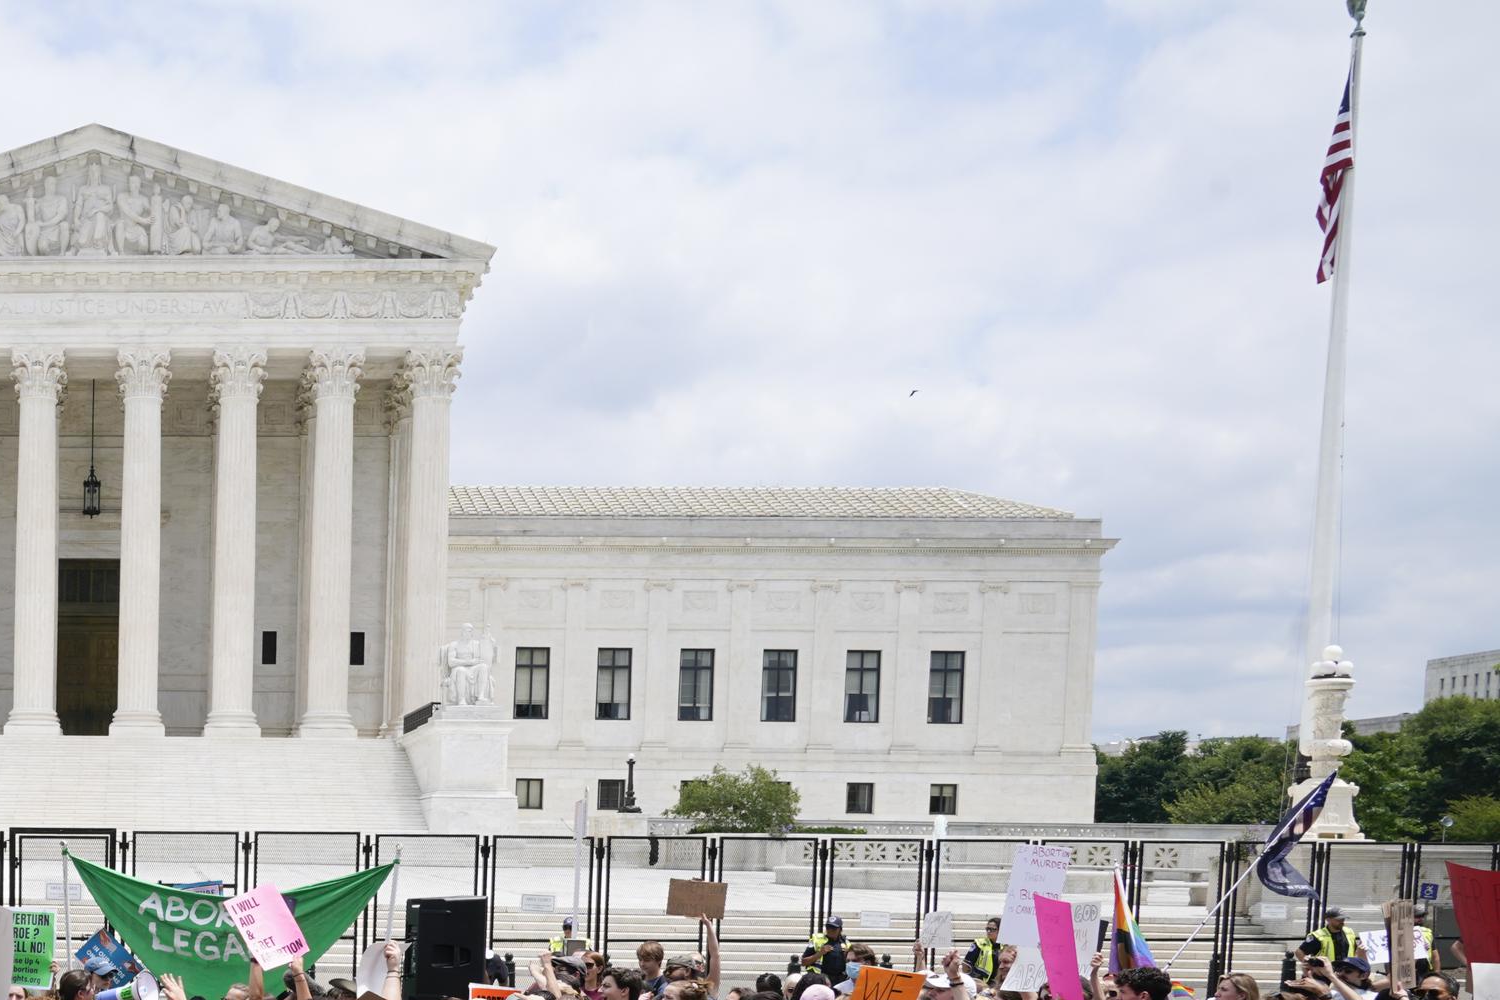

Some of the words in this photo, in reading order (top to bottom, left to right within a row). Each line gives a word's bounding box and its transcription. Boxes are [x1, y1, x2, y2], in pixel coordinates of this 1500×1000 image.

[28, 299, 104, 315] JUSTICE
[116, 299, 180, 315] UNDER
[192, 299, 229, 315] LAW
[1032, 846, 1072, 859] ABORTION
[1030, 857, 1068, 870] MURDER
[238, 896, 260, 913] WILL
[1074, 904, 1099, 922] GOD
[239, 913, 255, 928] AID
[246, 930, 255, 940] &
[30, 942, 46, 953] NO!
[24, 959, 33, 967] Up
[13, 977, 41, 986] ghts.org
